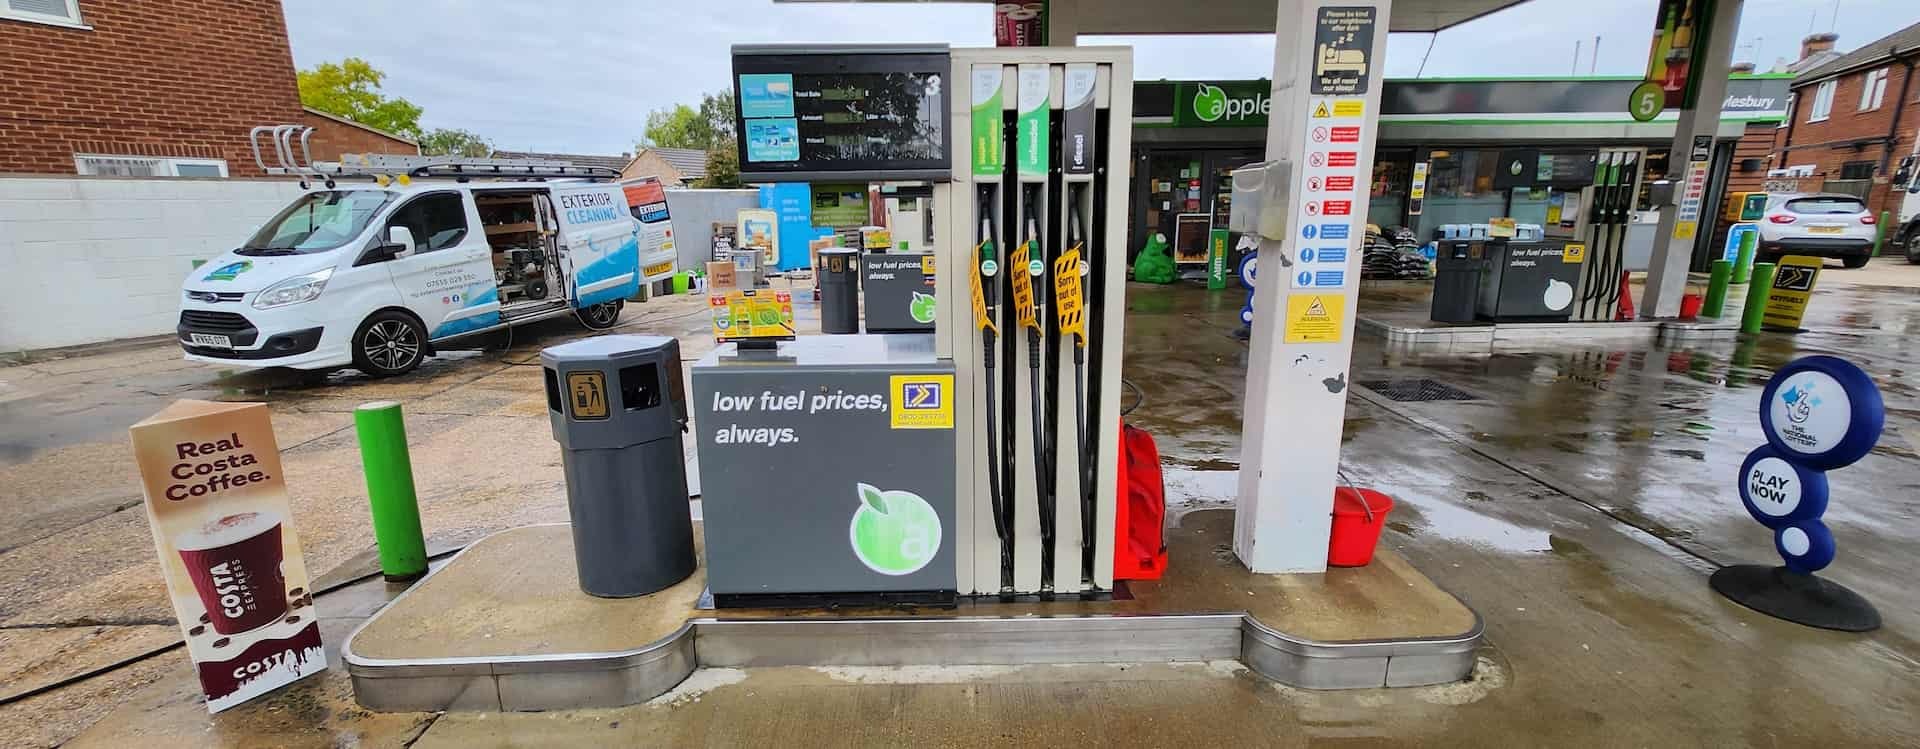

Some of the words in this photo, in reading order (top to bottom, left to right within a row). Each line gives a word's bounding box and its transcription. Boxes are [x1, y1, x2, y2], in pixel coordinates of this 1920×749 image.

[925, 75, 941, 96] 3
[1639, 92, 1656, 115] 5
[1028, 118, 1039, 165] unleaded
[1073, 134, 1084, 165] diesel
[561, 193, 613, 209] EXTERIOR
[566, 207, 617, 225] CLEANING
[1511, 247, 1525, 257] low
[1526, 247, 1541, 257] fuel
[868, 261, 882, 270] low
[883, 261, 898, 269] fuel
[1510, 260, 1537, 268] always.
[868, 273, 896, 281] always.
[1057, 275, 1075, 288] Sorry
[1058, 289, 1070, 299] out
[1070, 286, 1077, 297] of
[1063, 301, 1075, 311] use
[712, 391, 754, 411] low
[760, 390, 806, 411] fuel
[809, 389, 889, 414] prices,
[714, 423, 801, 447] always.
[1783, 429, 1816, 441] NATIONAL
[1786, 436, 1816, 447] LOTTERY
[176, 432, 244, 460] Real
[170, 453, 258, 480] Costa
[165, 470, 271, 502] Coffee.
[1753, 470, 1789, 490] PLAY
[1751, 483, 1786, 504] NOW
[210, 561, 245, 619] COSTA
[231, 558, 255, 606] EXPRESS
[233, 648, 298, 679] COSTA
